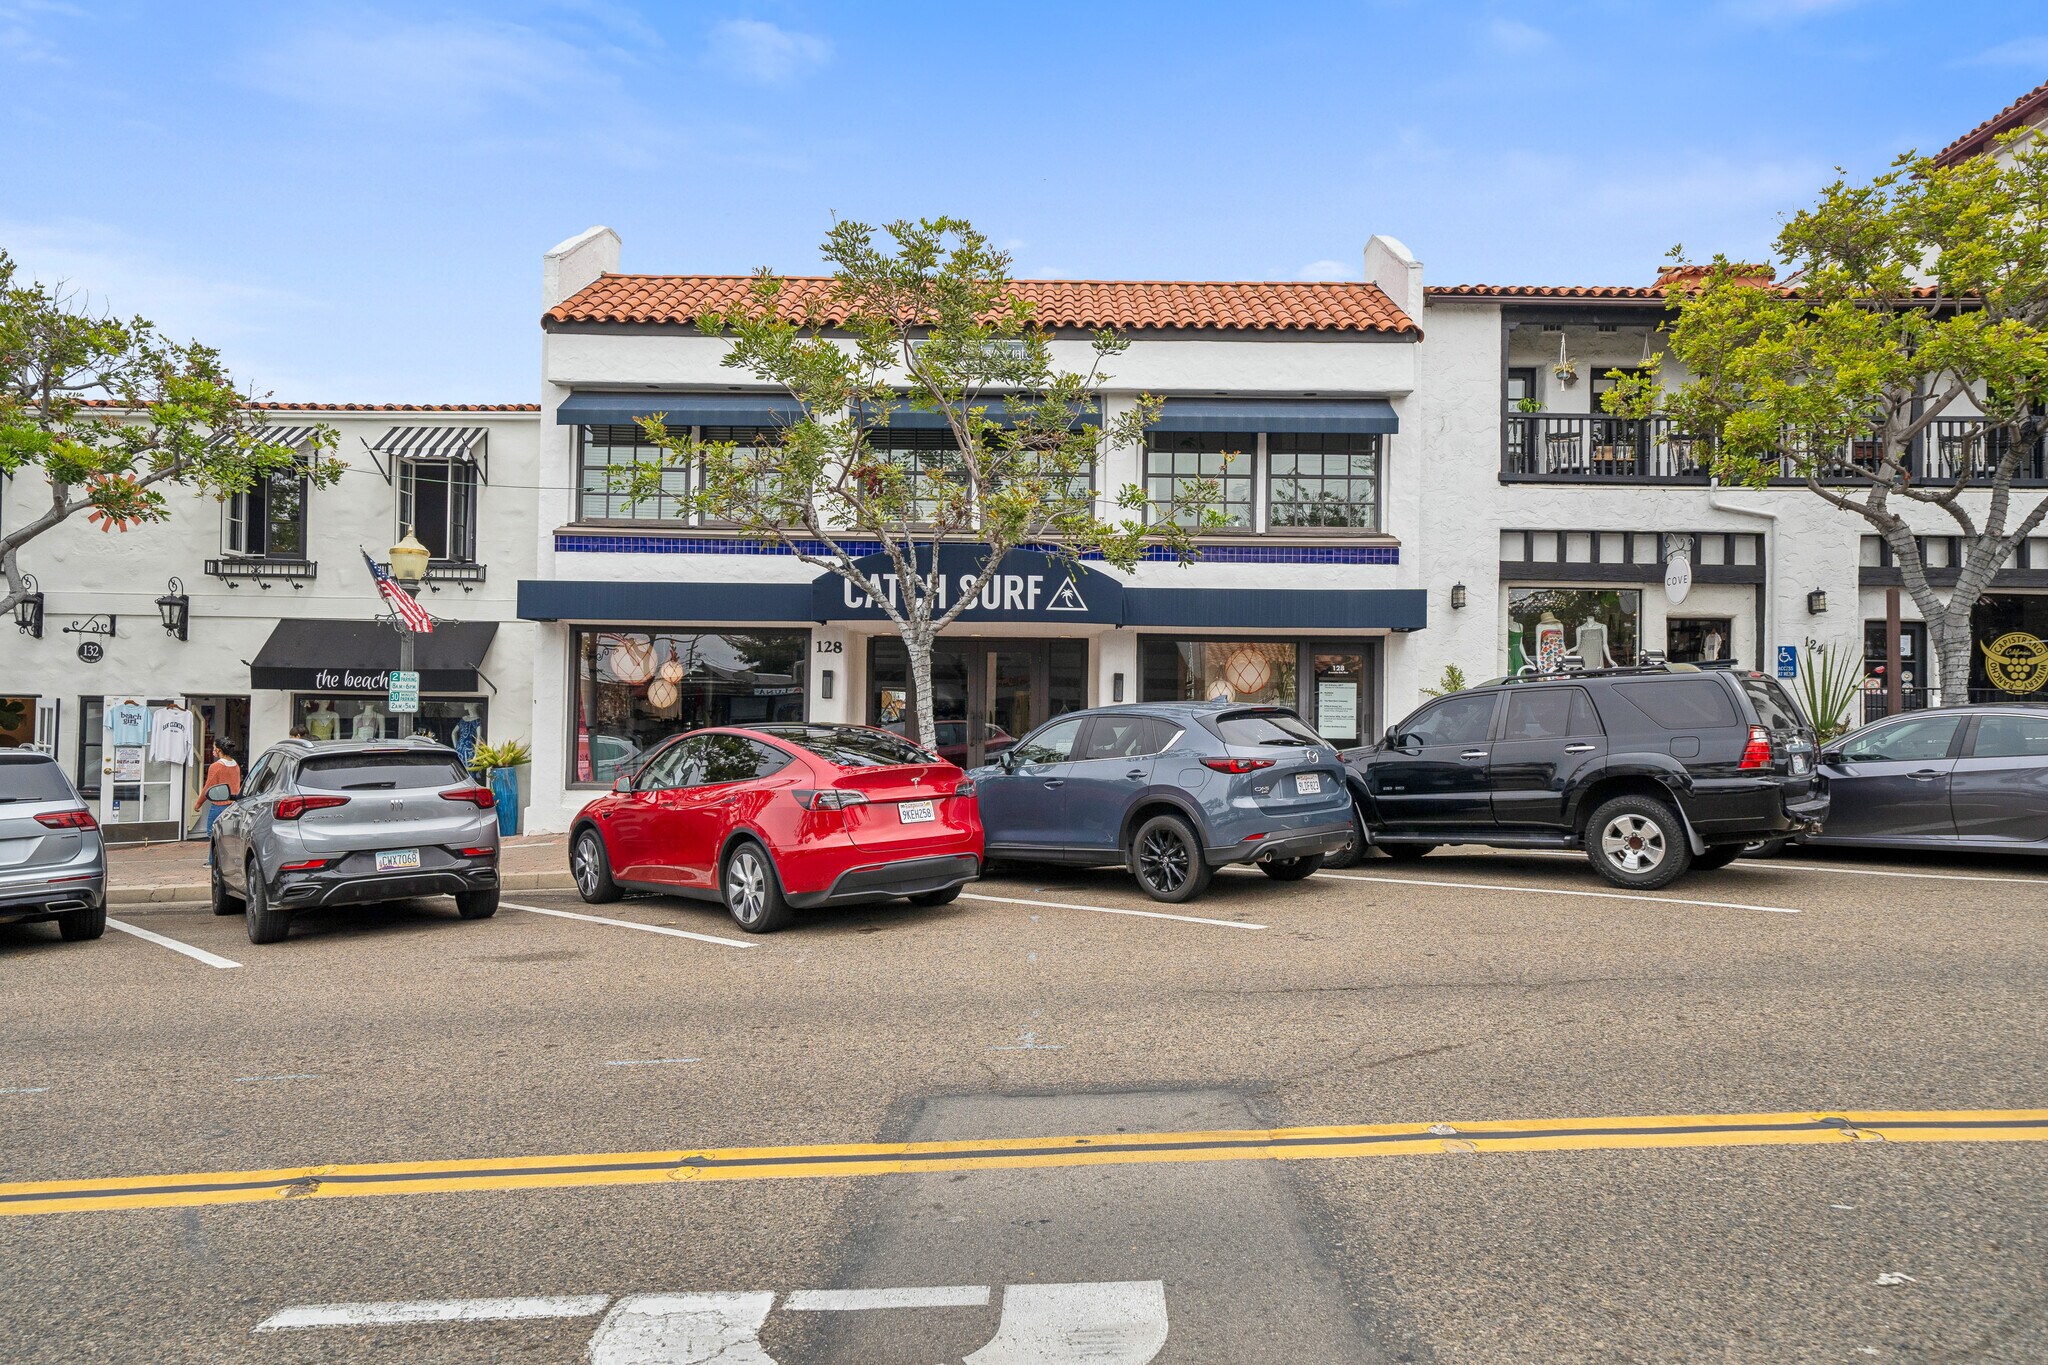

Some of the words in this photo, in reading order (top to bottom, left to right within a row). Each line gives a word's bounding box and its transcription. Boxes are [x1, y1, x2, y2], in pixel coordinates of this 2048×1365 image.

[1667, 575, 1687, 586] COVE
[844, 573, 946, 609] CATH
[960, 574, 1043, 610] SURF
[83, 645, 99, 657] 132
[816, 640, 843, 654] 128
[1805, 636, 1824, 655] 124
[1332, 664, 1345, 672] 128
[316, 669, 339, 689] the
[344, 669, 388, 690] beach
[392, 672, 399, 681] 2
[1990, 662, 2015, 690] RANCHO
[2023, 664, 2048, 690] WINERY
[391, 692, 399, 701] 30
[120, 712, 142, 720] beach
[902, 808, 932, 820] 9KEH258
[382, 854, 417, 867] CWX7068
